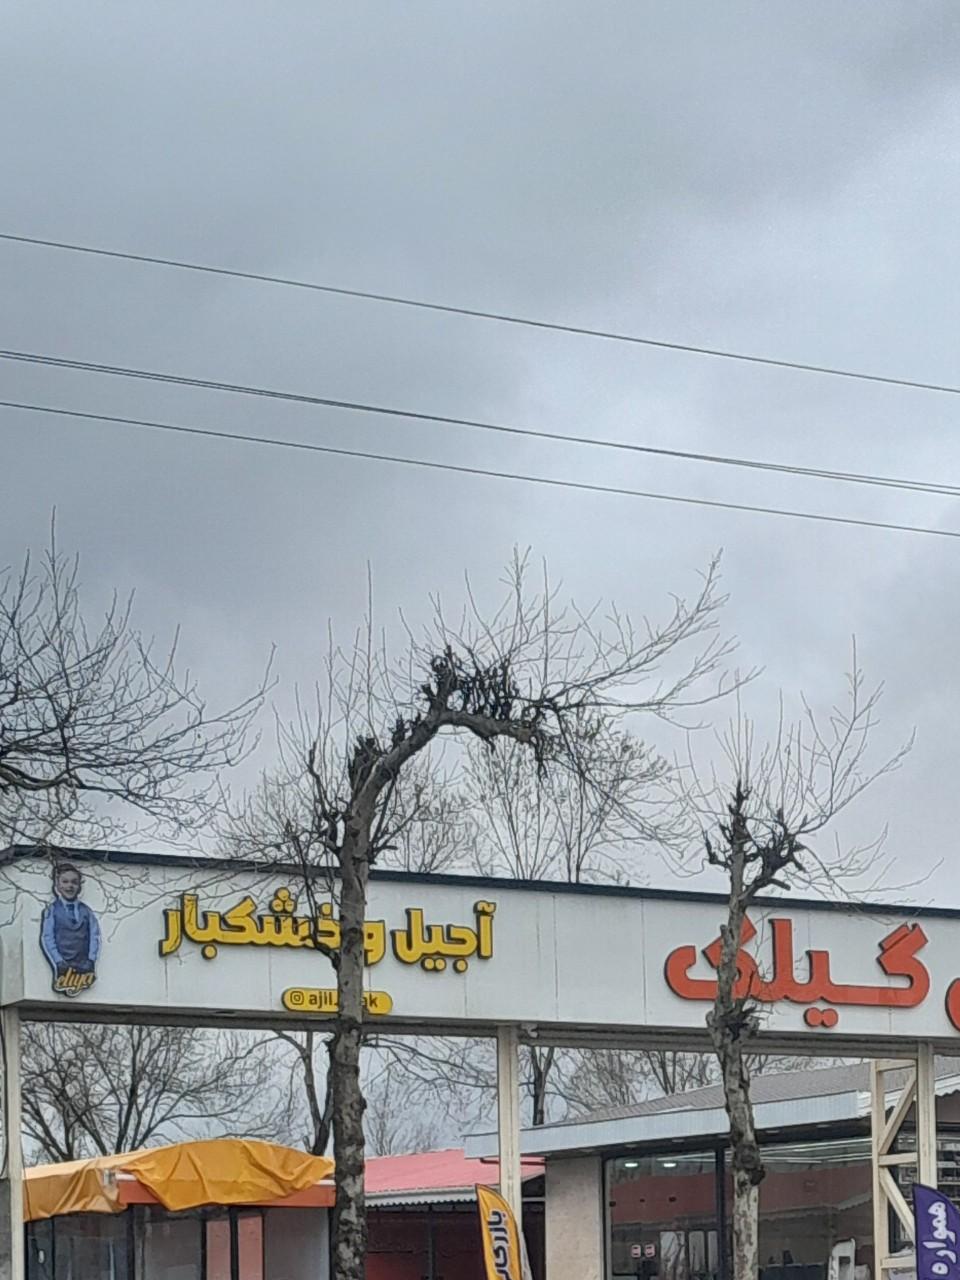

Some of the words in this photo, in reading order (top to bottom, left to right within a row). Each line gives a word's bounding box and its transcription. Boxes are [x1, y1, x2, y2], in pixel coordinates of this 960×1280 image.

[159, 886, 341, 960] خشکبار
[390, 900, 495, 973] آجیل
[664, 911, 931, 1028] گیلک
[922, 1200, 957, 1276] همواره
